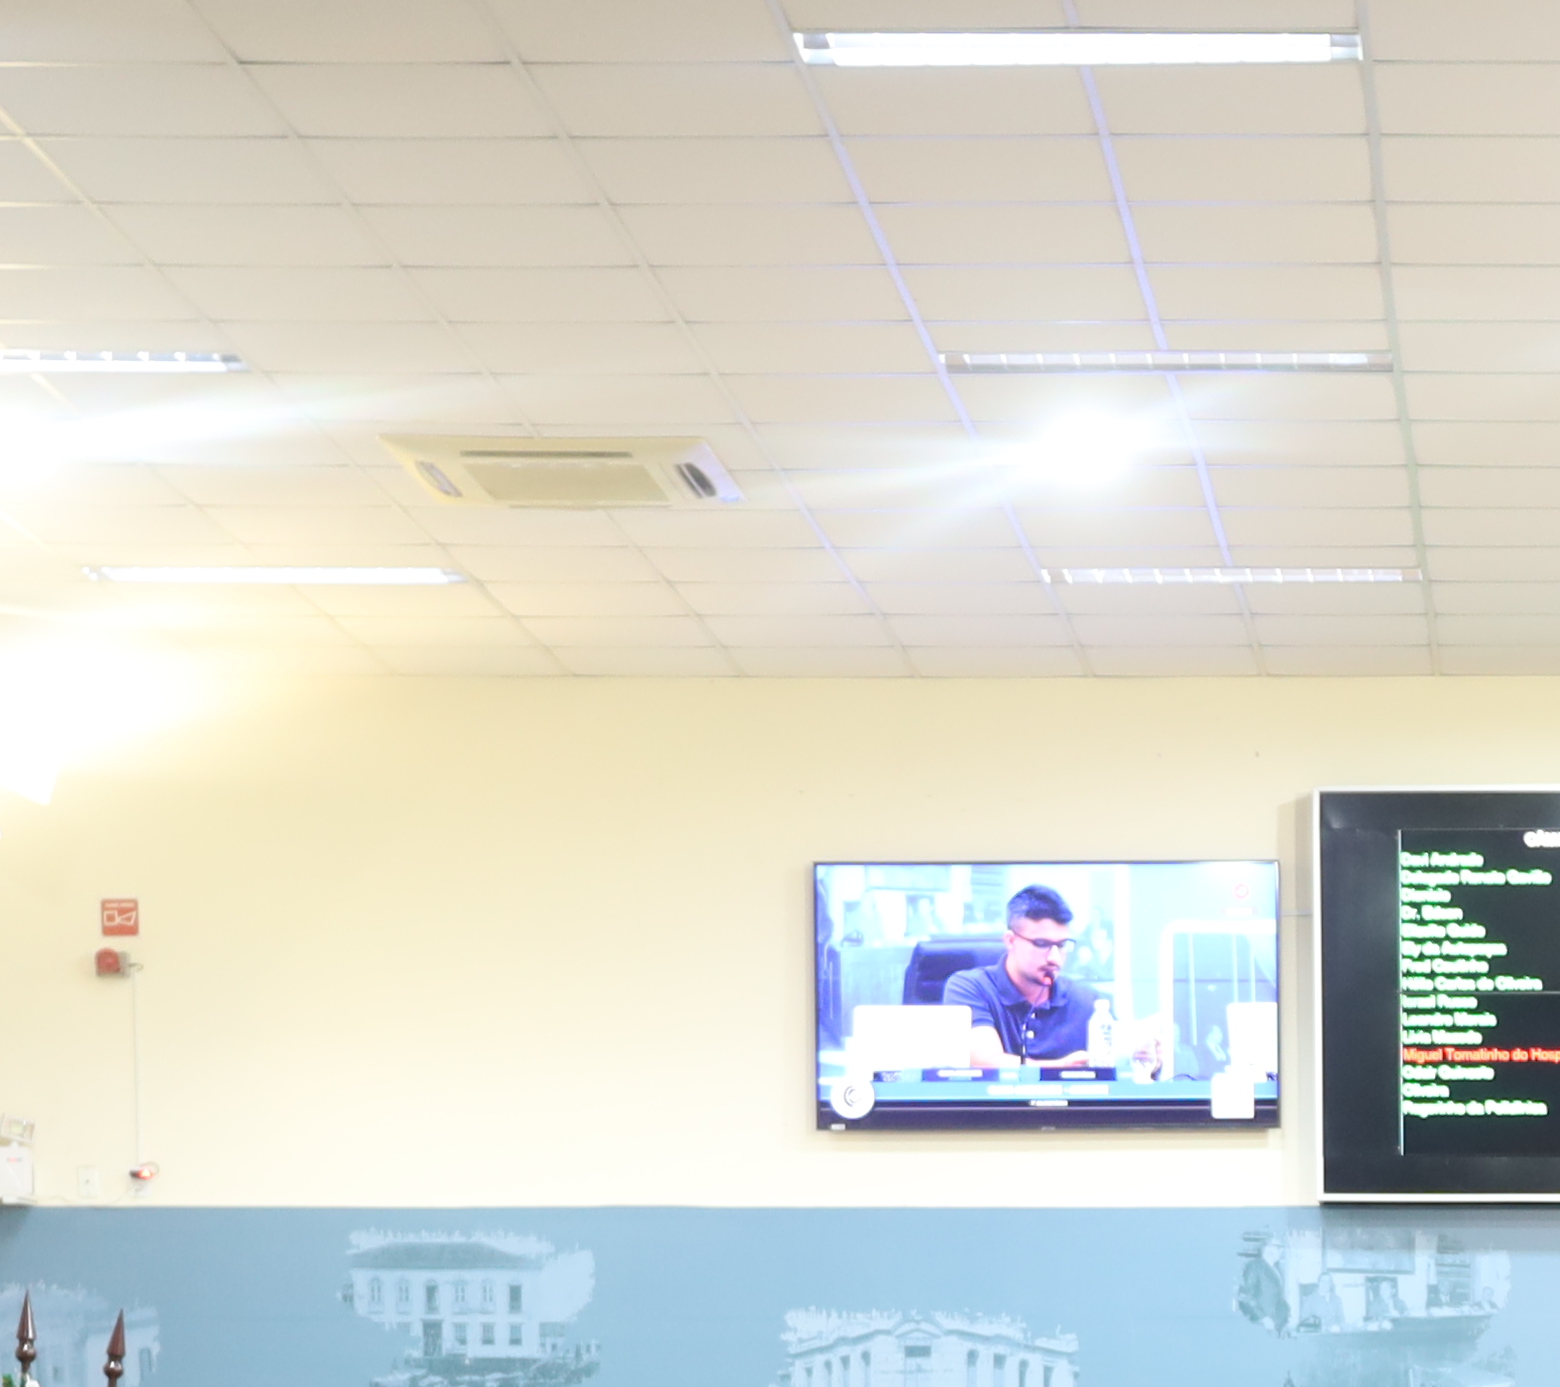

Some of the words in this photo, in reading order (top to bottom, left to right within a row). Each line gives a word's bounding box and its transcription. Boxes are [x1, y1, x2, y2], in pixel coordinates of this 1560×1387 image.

[1402, 1048, 1443, 1063] Miguel
[1444, 1048, 1510, 1061] Tomatinho
[1511, 1048, 1529, 1061] do
